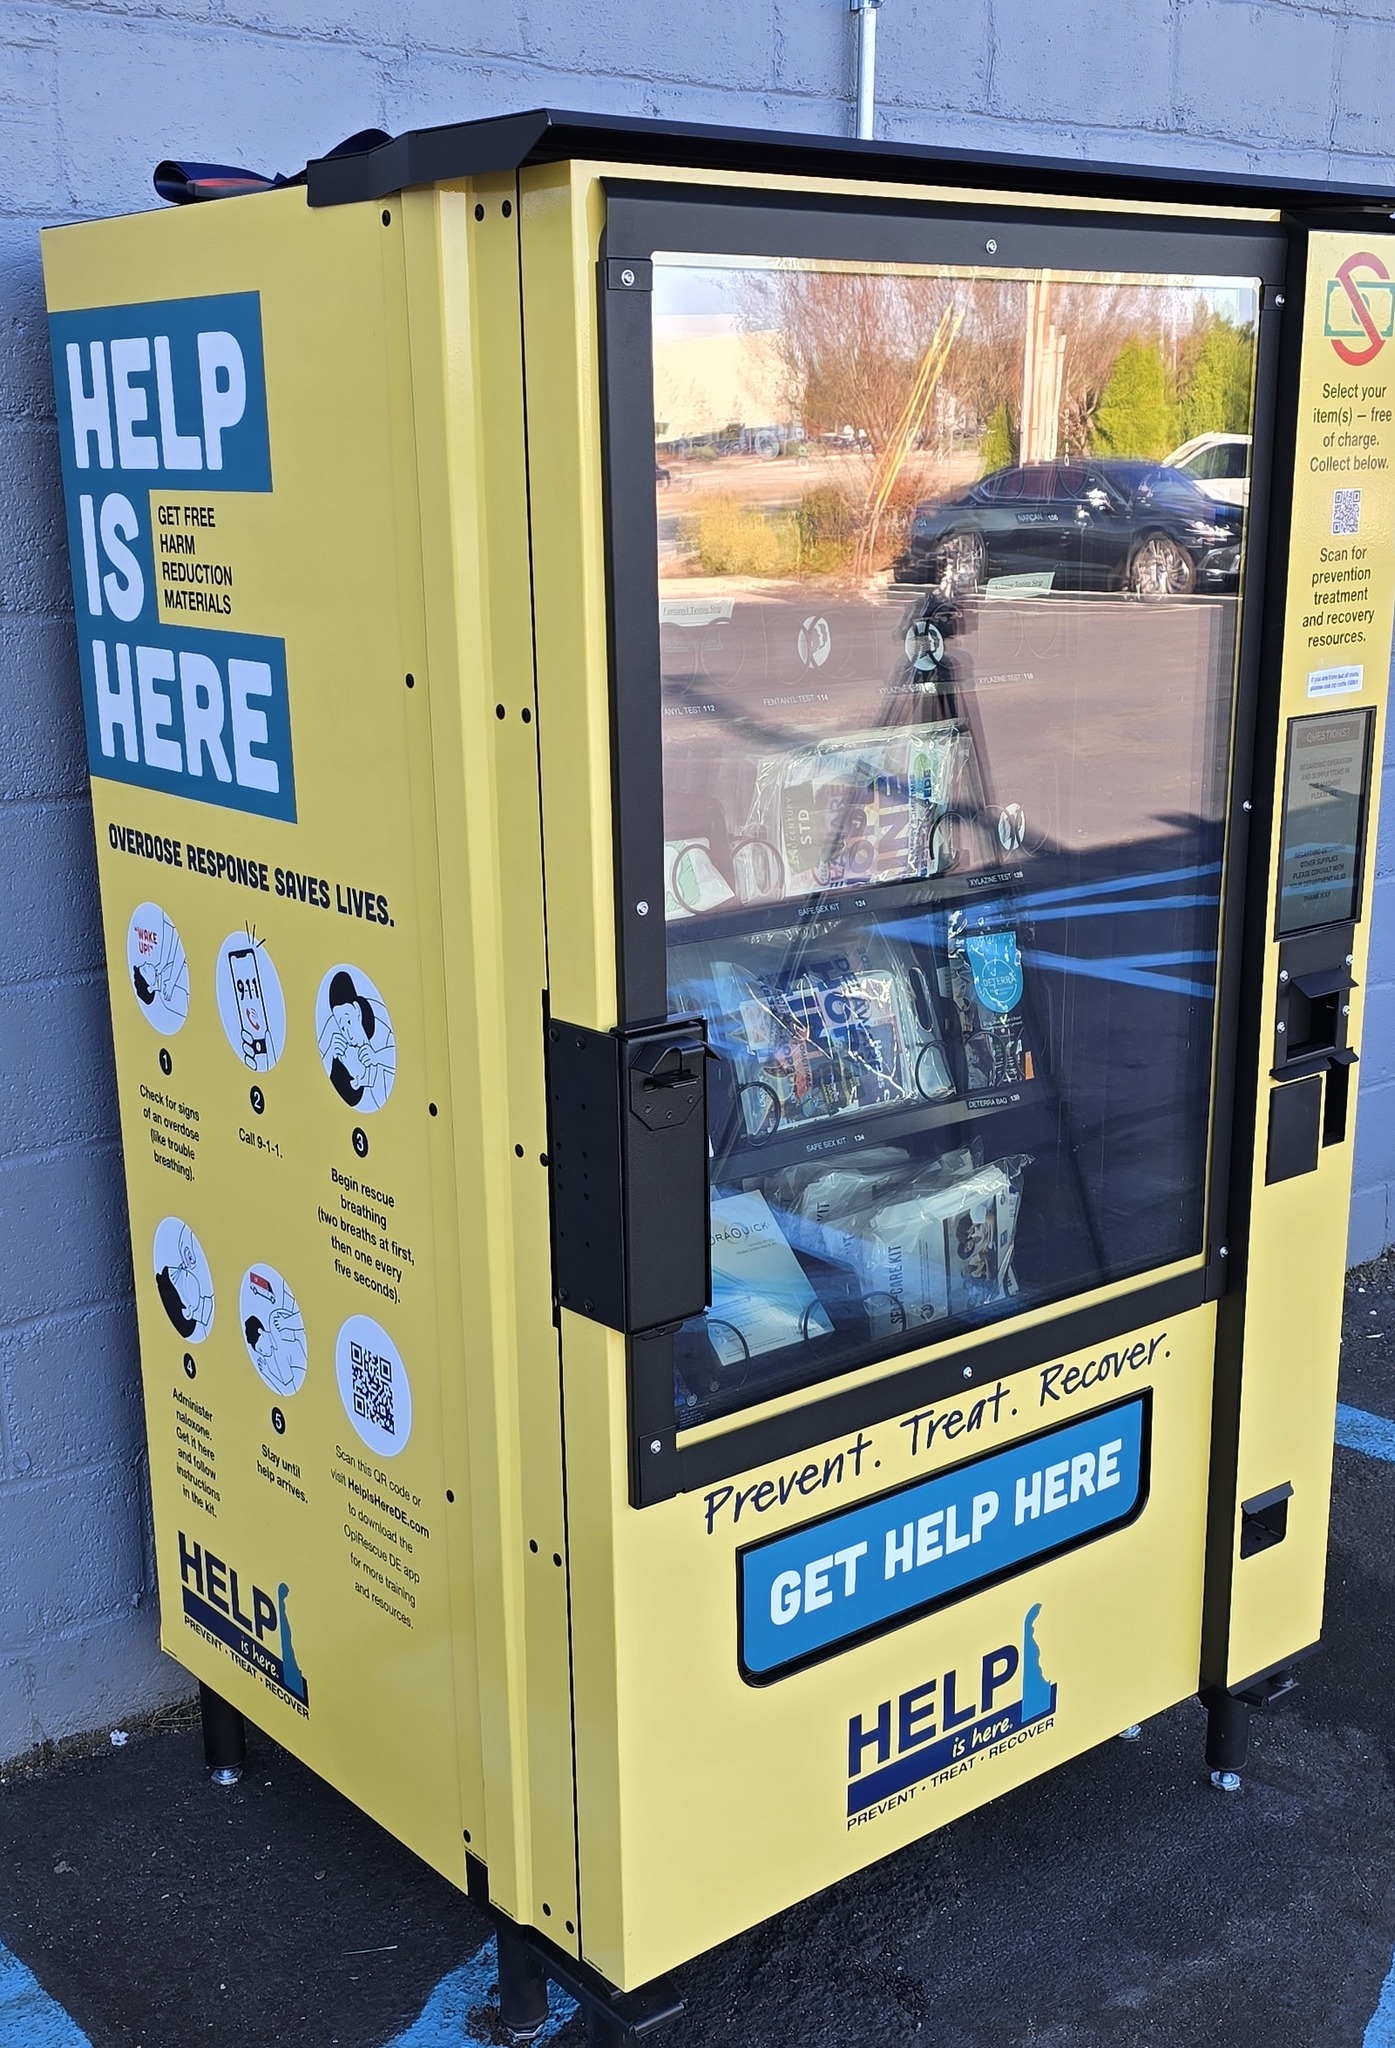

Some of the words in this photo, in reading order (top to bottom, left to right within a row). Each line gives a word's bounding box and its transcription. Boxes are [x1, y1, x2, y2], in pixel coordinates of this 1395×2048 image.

[66, 331, 246, 470] HELP
[1322, 383, 1358, 399] Select
[1361, 385, 1387, 401] your
[1313, 407, 1352, 426] item(s)
[1371, 407, 1392, 422] free
[1323, 432, 1336, 448] of
[1338, 432, 1380, 450] charge.
[1310, 456, 1350, 472] Collect
[1354, 455, 1389, 471] below.
[158, 506, 180, 526] GET
[184, 507, 216, 528] FREE
[79, 492, 144, 622] IS
[160, 533, 196, 556] HARM
[1320, 548, 1348, 562] Scan
[1352, 546, 1368, 560] for
[162, 562, 232, 586] REDUCTION
[1312, 566, 1371, 588] prevention
[164, 590, 232, 616] MATERIALS
[1314, 587, 1368, 606] treatment
[1302, 612, 1324, 628] and
[1326, 608, 1374, 626] recovery
[1308, 631, 1366, 648] resources.
[92, 639, 280, 794] HERE
[683, 706, 701, 714] TEST
[702, 704, 716, 713] 112
[763, 696, 797, 706] FENTANYL
[798, 694, 815, 703] TEST
[816, 694, 829, 702] 114
[798, 809, 812, 845] STD
[108, 823, 182, 868] OVERDOSE
[186, 844, 270, 892] RESPONSE
[274, 868, 330, 910] SAVES
[336, 884, 394, 927] LIVES.
[970, 877, 997, 886] XYLAZINE
[998, 873, 1012, 882] TEST
[798, 907, 815, 916] SAFE
[814, 905, 828, 914] SEX
[828, 903, 840, 912] KIT
[855, 900, 866, 908] 124
[237, 978, 260, 1001] 9-1-1
[162, 1054, 168, 1070] 1
[140, 1084, 164, 1106] Check
[166, 1096, 176, 1111] for
[178, 1102, 200, 1122] signs
[254, 1091, 260, 1109] 2
[969, 1098, 995, 1109] DETERRA
[996, 1097, 1008, 1106] BAG
[143, 1107, 152, 1119] of
[152, 1112, 162, 1125] an
[164, 1116, 200, 1142] overdose
[150, 1128, 166, 1146] (like
[168, 1136, 196, 1160] trouble
[238, 1128, 256, 1146] Call
[257, 1136, 283, 1158] 9-1-1.
[356, 1133, 364, 1152] 3
[806, 1142, 823, 1152] SAFE
[824, 1140, 836, 1149] SEX
[836, 1137, 847, 1146] KIT
[854, 1134, 865, 1142] 134
[154, 1149, 195, 1182] breathing).
[331, 1168, 358, 1192] Begin
[361, 1183, 394, 1208] rescue
[340, 1194, 387, 1230] breathing
[318, 1206, 338, 1228] (two
[340, 1216, 376, 1246] breaths
[380, 1237, 389, 1252] at
[392, 1241, 415, 1266] first,
[331, 1235, 352, 1257] then
[354, 1248, 372, 1267] one
[376, 1259, 402, 1283] every
[888, 1245, 902, 1264] KIT
[334, 1258, 351, 1278] five
[354, 1270, 400, 1304] seconds).
[186, 1360, 194, 1375] 4
[172, 1387, 213, 1422] Administer
[275, 1412, 282, 1430] 5
[176, 1410, 212, 1441] naloxone.
[704, 1432, 882, 1535] Prevent.
[900, 1382, 1018, 1456] Treat.
[1039, 1332, 1172, 1407] Recover.
[176, 1426, 190, 1442] Get
[191, 1436, 197, 1450] it
[198, 1441, 216, 1462] here
[178, 1448, 192, 1466] and
[193, 1456, 216, 1481] follow
[261, 1444, 280, 1468] Stay
[282, 1458, 302, 1479] until
[335, 1445, 356, 1468] Scan
[357, 1458, 372, 1478] this
[374, 1469, 388, 1488] QR
[389, 1479, 410, 1502] code
[412, 1495, 422, 1508] or
[176, 1462, 221, 1502] instructions
[256, 1460, 275, 1484] help
[276, 1476, 308, 1504] arrives.
[182, 1484, 190, 1499] in
[192, 1493, 204, 1509] the
[204, 1501, 218, 1518] kit.
[330, 1468, 347, 1487] visit
[348, 1477, 430, 1540] HelpIsHereDE.com
[348, 1502, 356, 1517] to
[358, 1510, 398, 1544] download
[399, 1536, 414, 1554] the
[770, 1540, 868, 1626] GET
[884, 1490, 1000, 1581] HELP
[1014, 1438, 1122, 1527] HERE
[344, 1524, 388, 1562] OpiRescue
[389, 1554, 402, 1572] DE
[404, 1566, 420, 1586] app
[178, 1530, 278, 1642] HELP
[350, 1552, 362, 1569] for
[362, 1564, 384, 1584] more
[386, 1576, 416, 1610] training
[354, 1581, 370, 1600] and
[371, 1593, 414, 1630] resources.
[184, 1614, 223, 1652] PREVENT
[230, 1650, 258, 1680] TREAT
[265, 1678, 310, 1721] RECOVER
[240, 1636, 250, 1655] is
[252, 1644, 280, 1679] here.
[848, 1644, 1020, 1778] HELP
[951, 1735, 966, 1758] is
[972, 1716, 1014, 1747] here.
[846, 1786, 916, 1832] PREVENT
[931, 1756, 976, 1789] TREAT
[989, 1717, 1055, 1760] RECOVER
